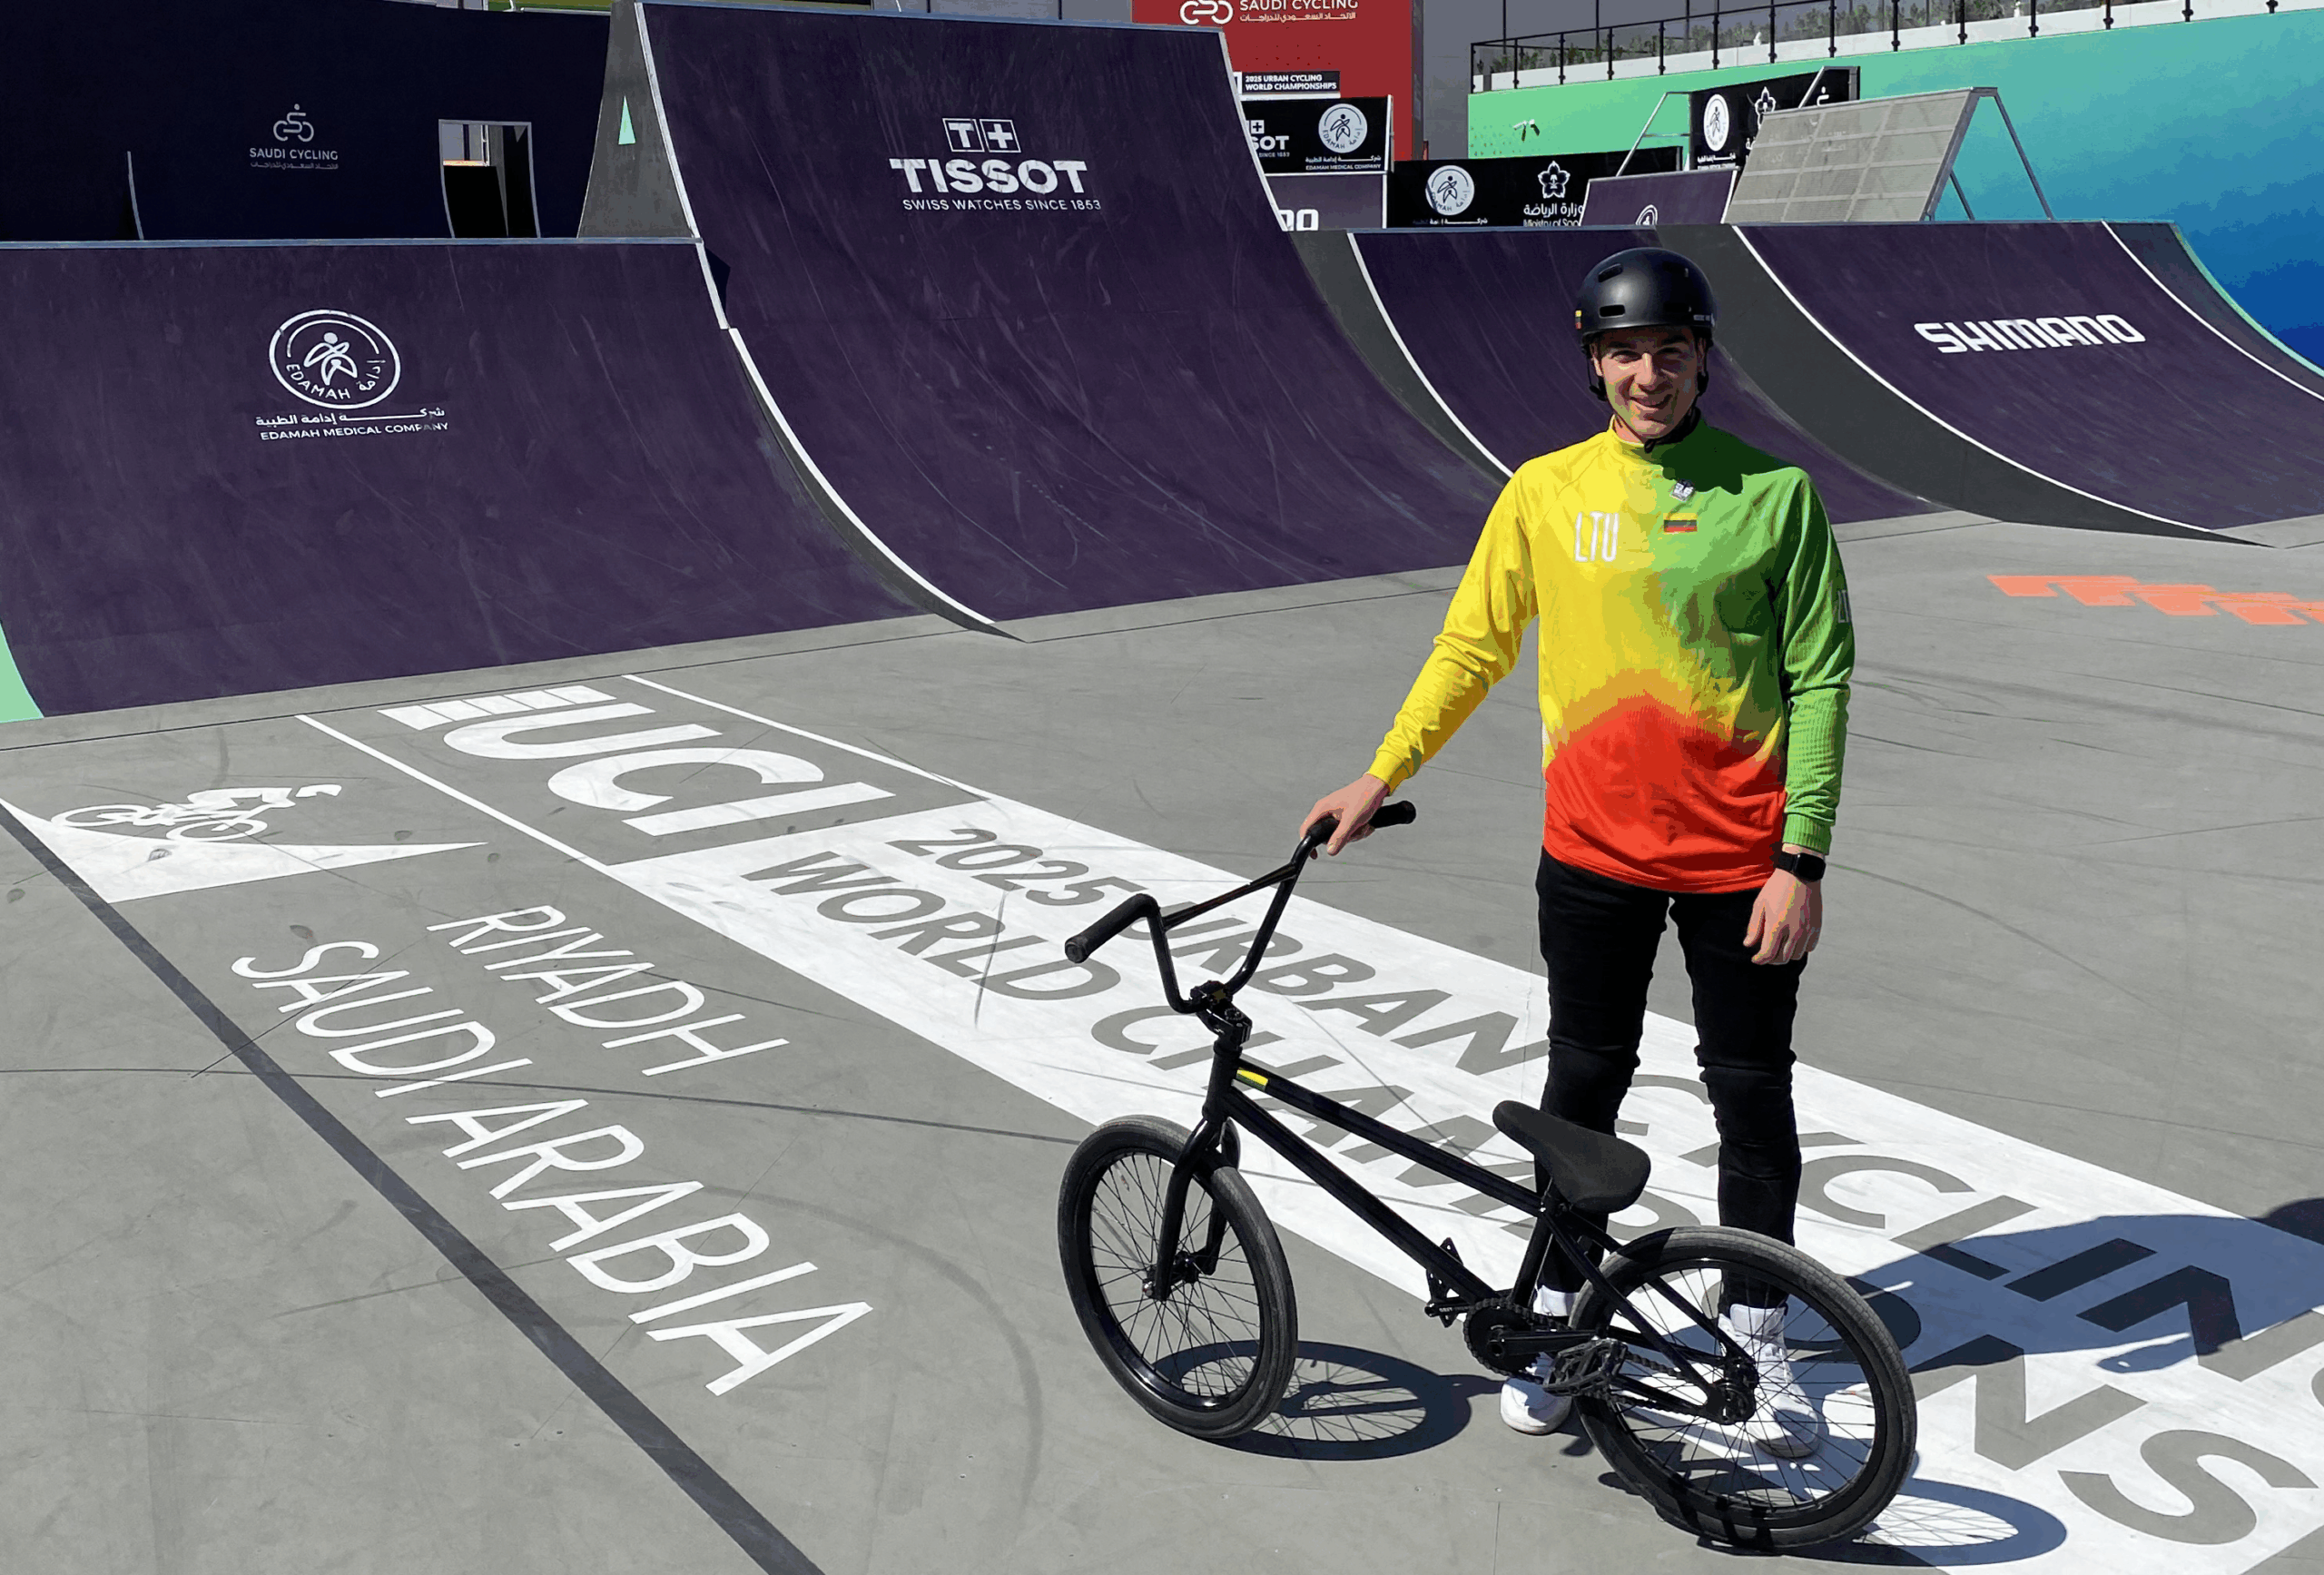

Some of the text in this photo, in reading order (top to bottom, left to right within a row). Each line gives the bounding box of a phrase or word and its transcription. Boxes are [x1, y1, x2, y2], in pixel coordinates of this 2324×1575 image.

[1240, 0, 1358, 10] SAUDI CYCLING
[1245, 82, 1337, 91] WORLD CHAMPIONSHIPS
[1263, 74, 1289, 83] URBAN
[250, 147, 339, 160] SAUDI CYCLING
[889, 158, 1088, 193] TISSOT
[902, 199, 1101, 211] SWISS WATCHES SINCE 1853
[1523, 202, 1557, 218] الرياضة
[1914, 314, 2146, 353] SHIMANO
[286, 363, 350, 399] EDAMAH
[255, 407, 445, 428] شركة إدامة الطبية
[260, 422, 448, 440] EDAMAH MEDICAL COMPANY
[1574, 510, 1620, 563] LTU
[443, 702, 897, 837] UCI
[740, 850, 1122, 1001] WORLD
[885, 828, 1147, 906] 2025
[1117, 901, 1551, 1076] URBAN
[427, 905, 791, 1077] RIYADH
[231, 940, 874, 1396] SAUDI ARABIA
